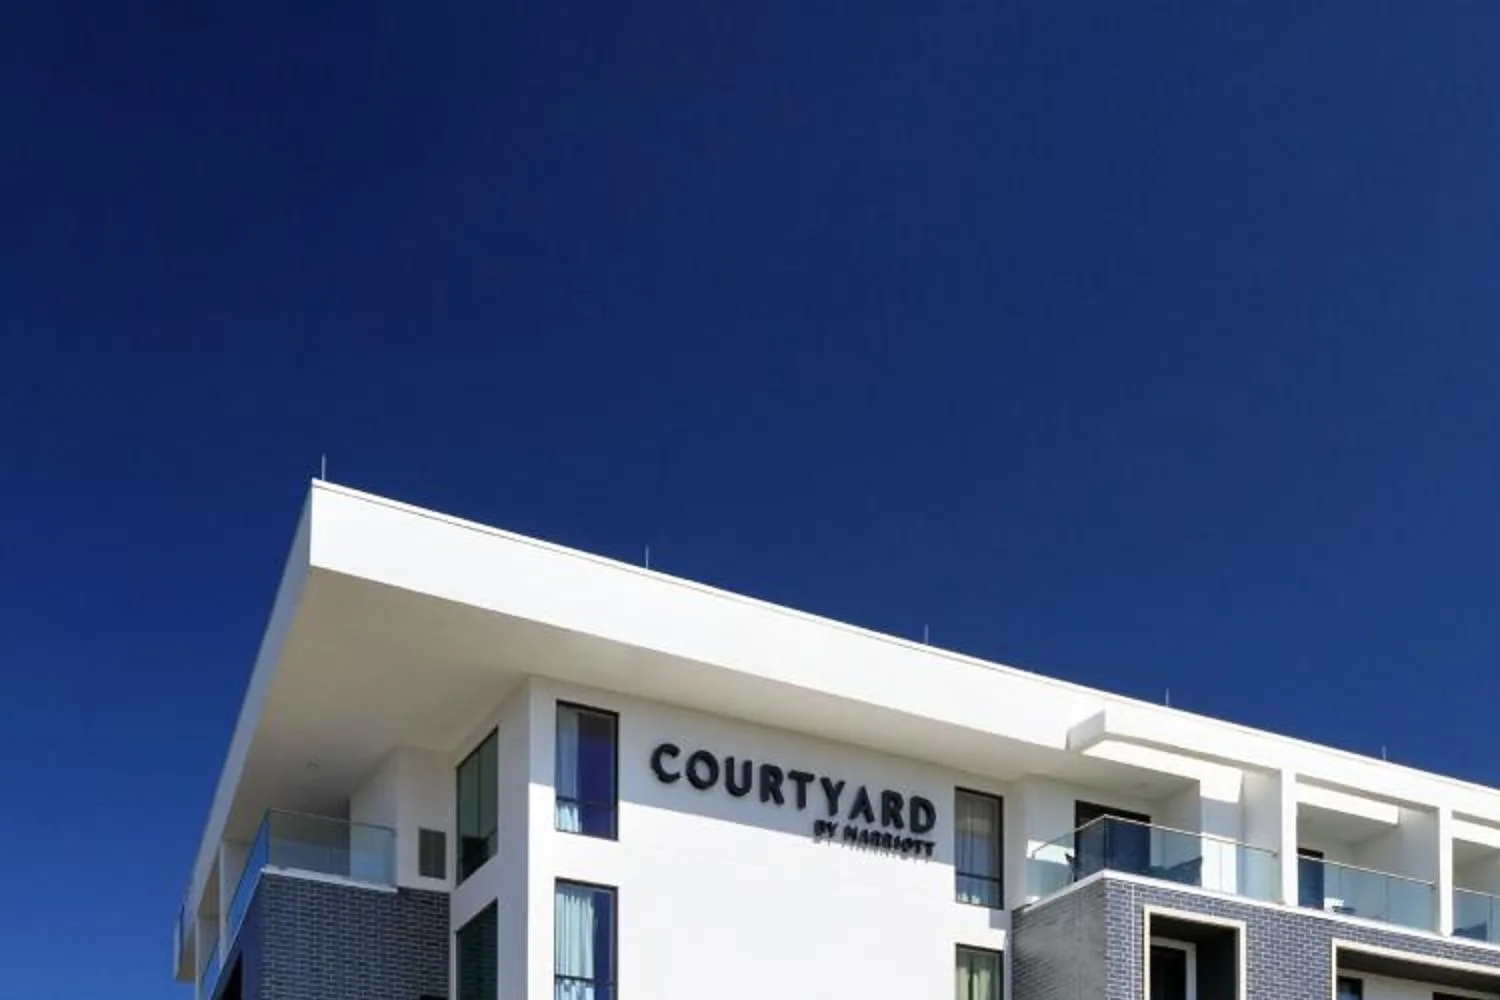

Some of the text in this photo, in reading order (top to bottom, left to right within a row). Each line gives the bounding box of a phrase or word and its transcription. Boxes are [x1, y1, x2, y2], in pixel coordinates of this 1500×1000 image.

[650, 743, 937, 834] COURTYARD
[814, 819, 936, 857] BY MARRIOTT
